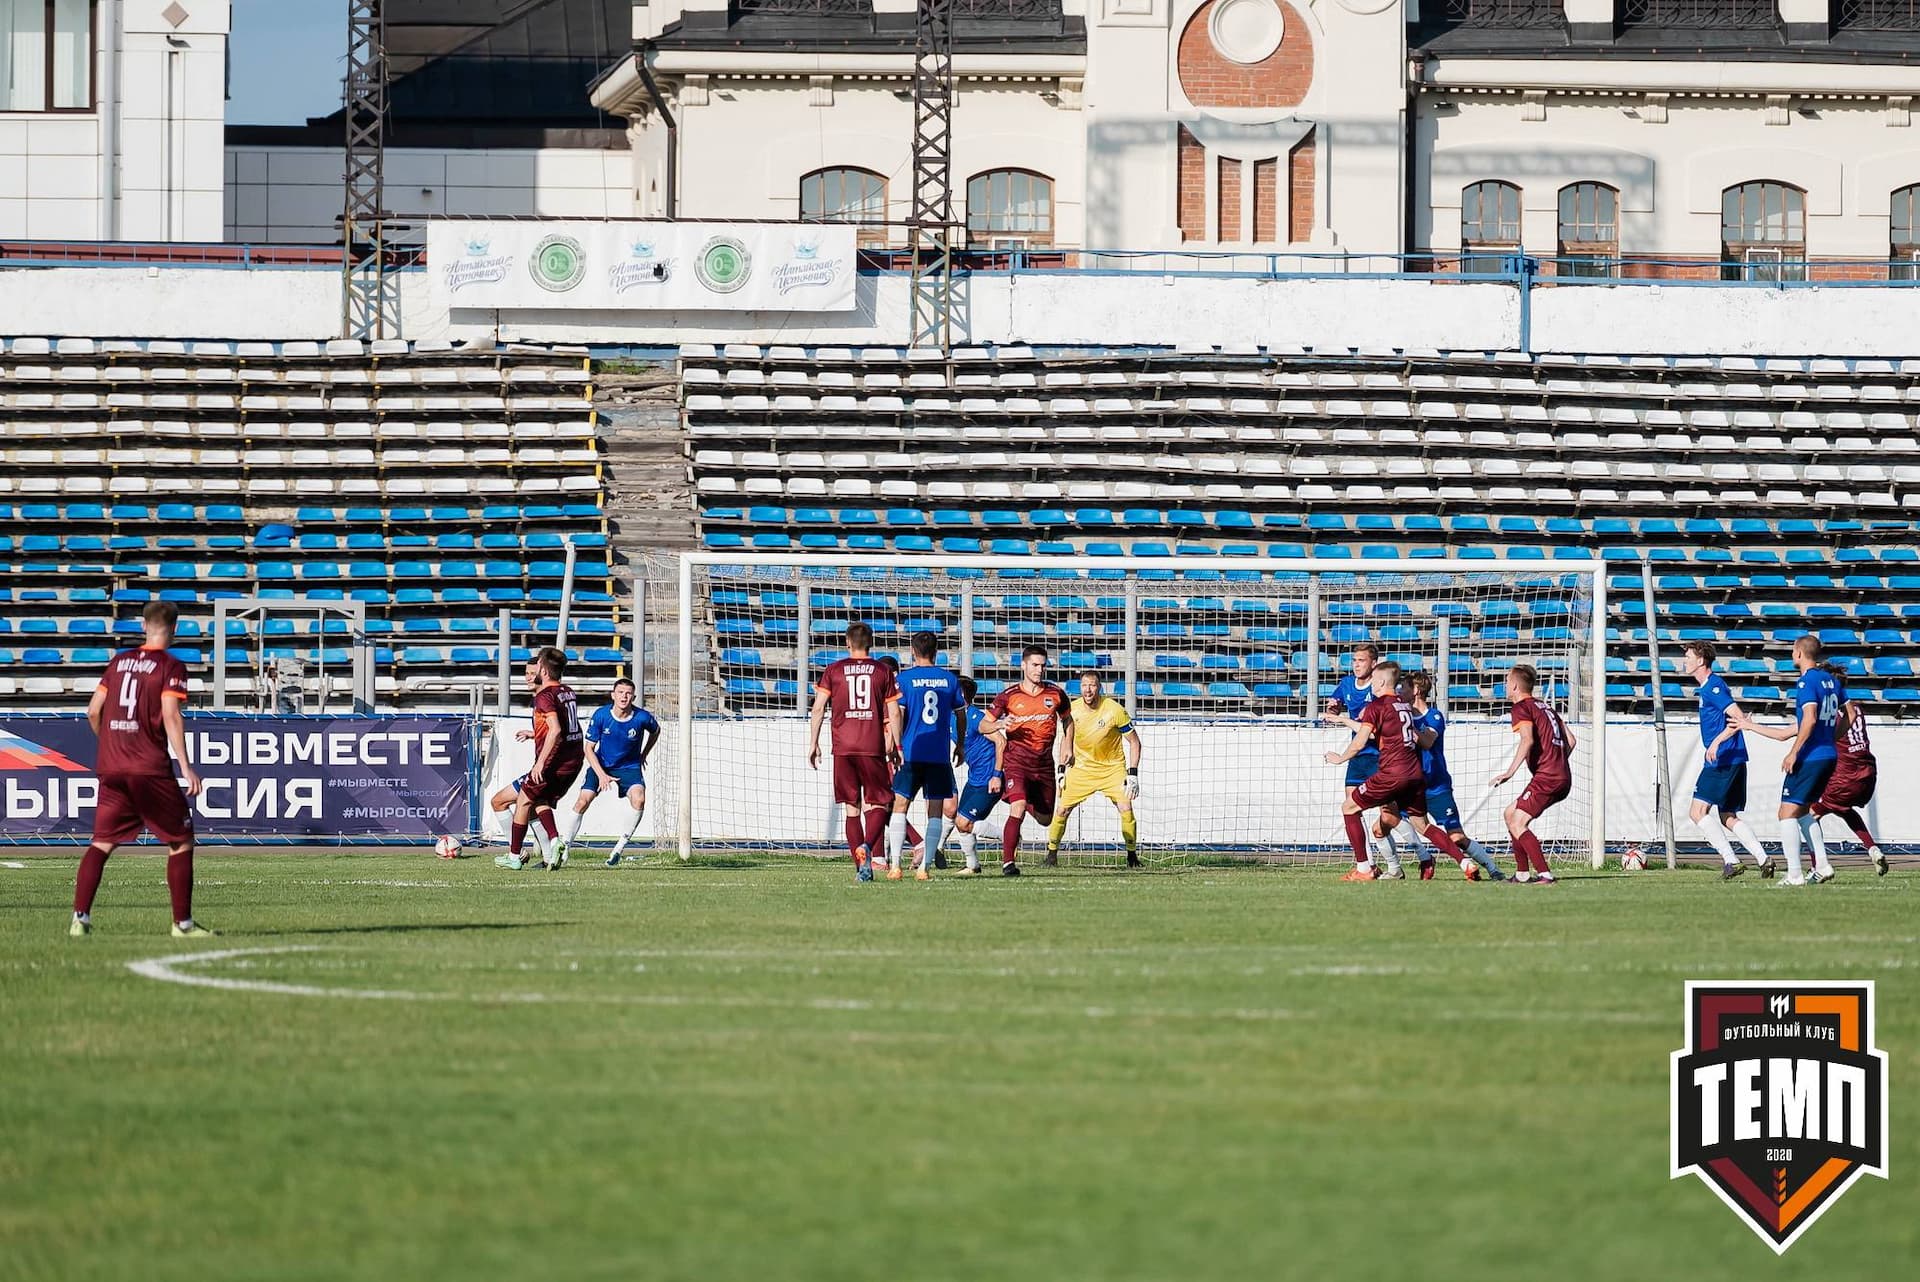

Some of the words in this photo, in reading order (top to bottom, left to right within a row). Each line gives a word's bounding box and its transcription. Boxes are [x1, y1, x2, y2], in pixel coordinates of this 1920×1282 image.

[119, 672, 138, 719] 4
[845, 674, 871, 710] 19
[922, 690, 939, 725] 8
[1819, 693, 1838, 727] 49
[328, 778, 408, 788] #МЫВМЕСТЕ
[342, 806, 449, 819] #МЫРОССИЯ
